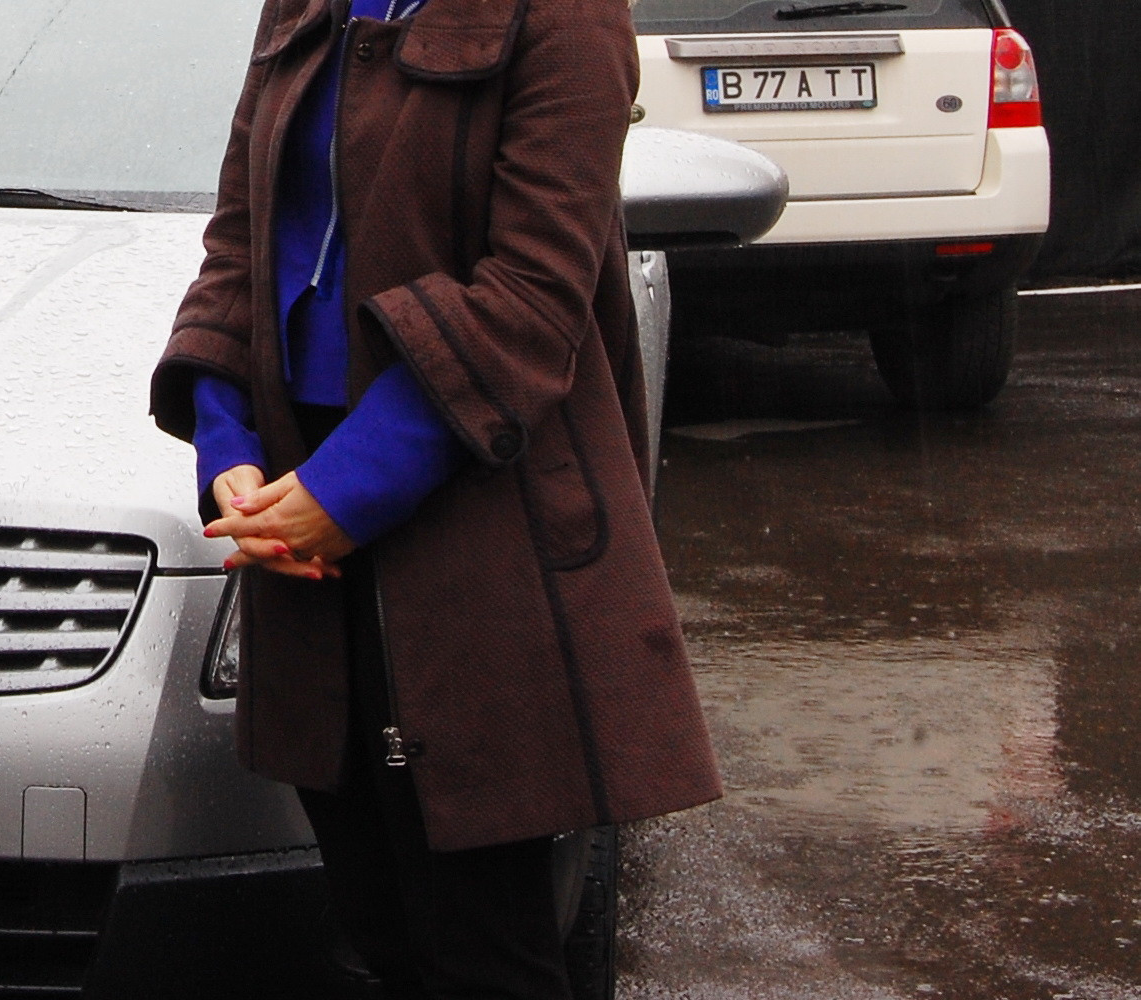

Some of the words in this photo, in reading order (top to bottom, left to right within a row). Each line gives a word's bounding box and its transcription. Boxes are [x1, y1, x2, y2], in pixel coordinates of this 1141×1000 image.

[722, 71, 742, 99] B
[752, 71, 786, 99] 77
[706, 88, 719, 101] RO
[780, 102, 807, 110] AUTO
